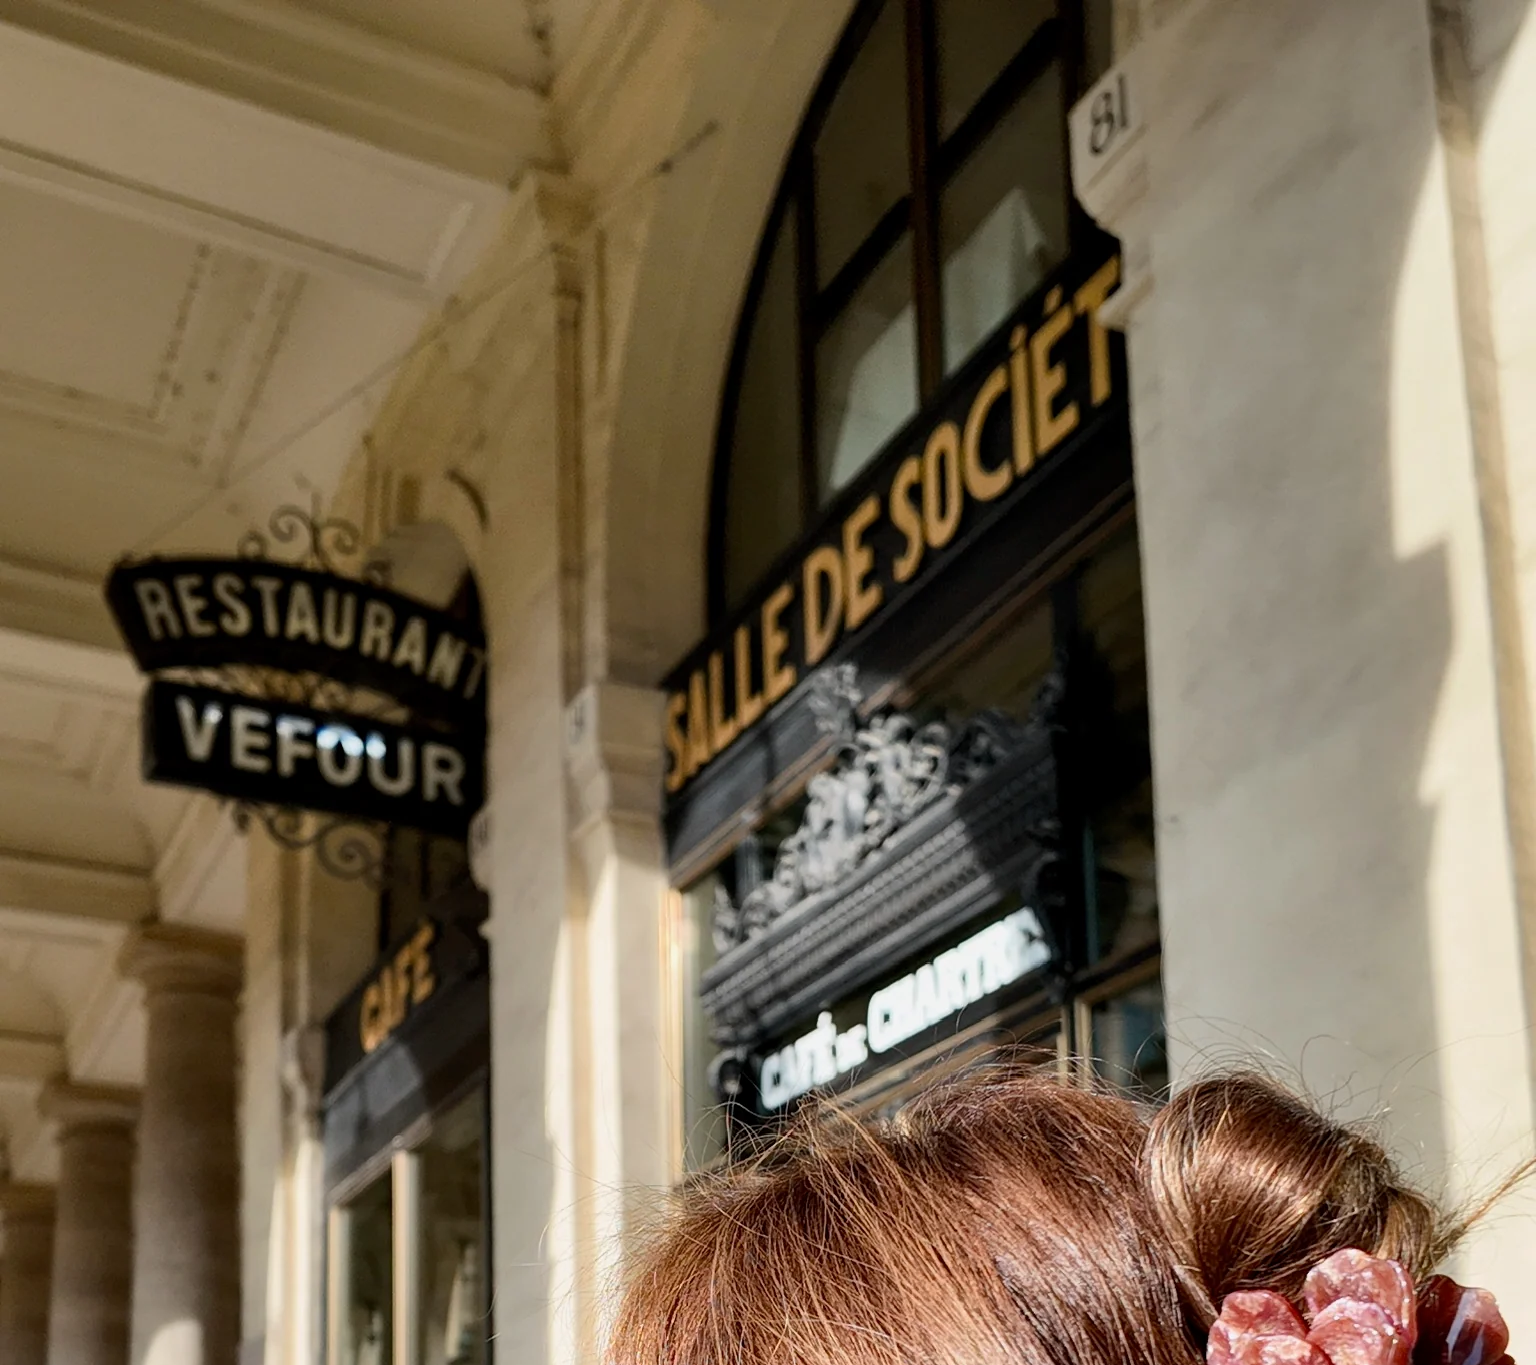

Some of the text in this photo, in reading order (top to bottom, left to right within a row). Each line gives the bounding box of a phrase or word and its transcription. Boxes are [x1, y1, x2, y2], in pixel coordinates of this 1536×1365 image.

[1089, 72, 1128, 156] 81
[135, 575, 487, 698] RESTAURANT
[665, 584, 797, 793] SALLE
[804, 495, 884, 665] DE
[175, 695, 466, 804] VEFOUR
